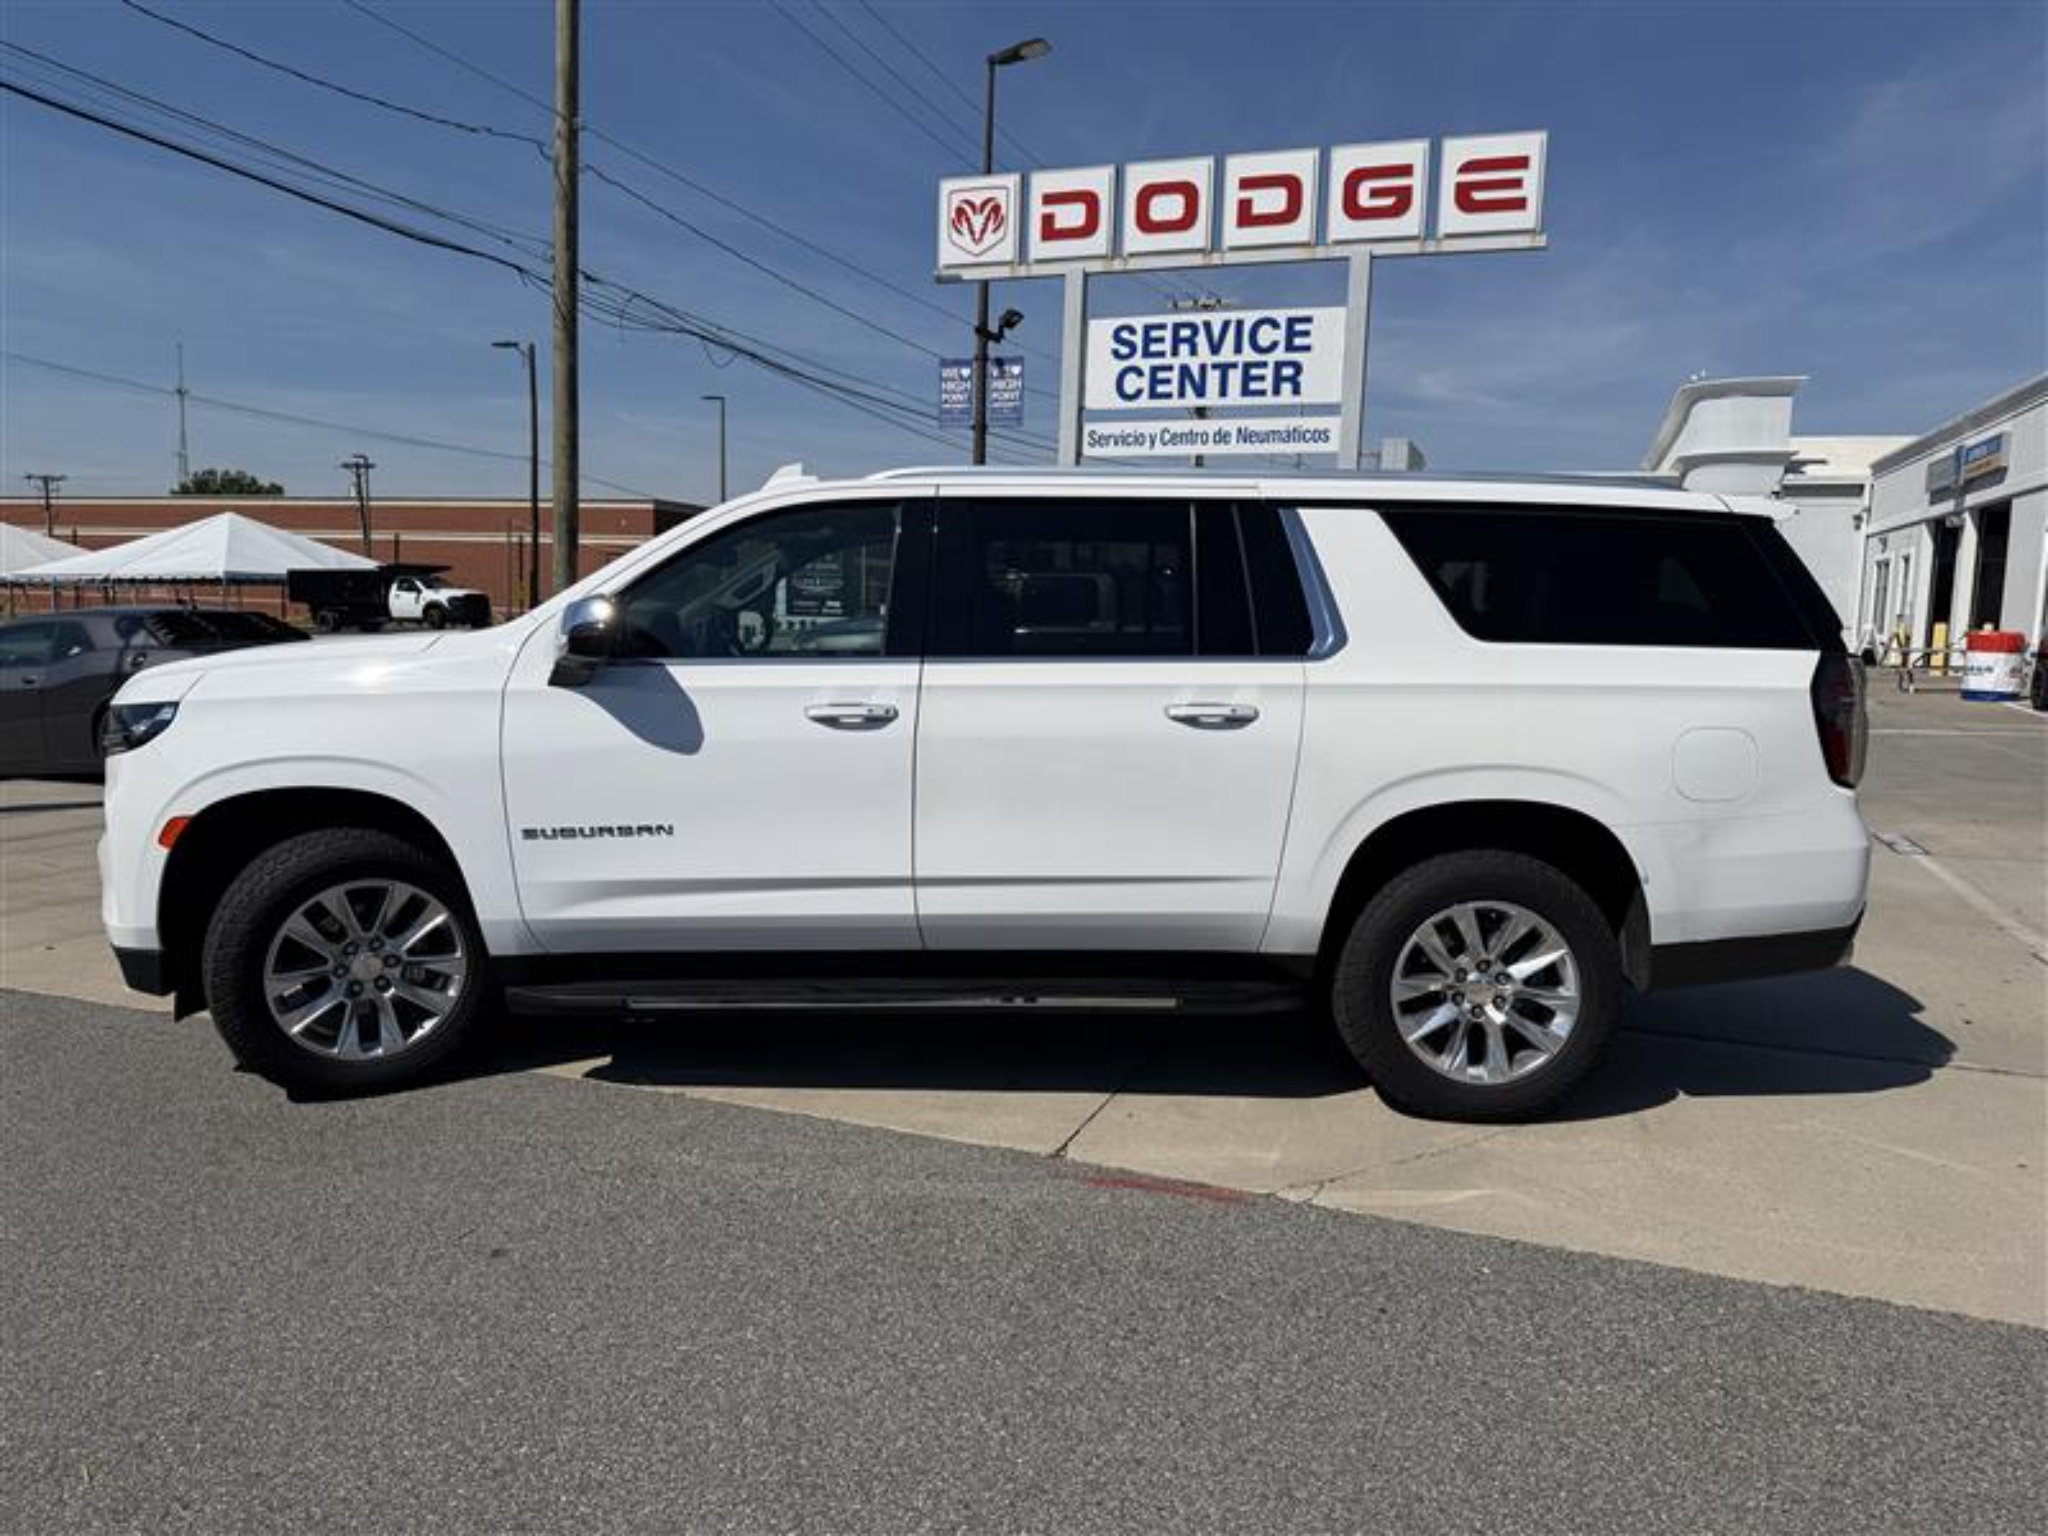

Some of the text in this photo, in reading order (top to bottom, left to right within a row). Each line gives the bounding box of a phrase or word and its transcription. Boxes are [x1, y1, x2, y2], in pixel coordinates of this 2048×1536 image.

[1040, 155, 1530, 242] DODGE
[1111, 316, 1313, 361] SERVICE
[1115, 360, 1304, 402] CENTER
[1087, 425, 1330, 450] Servicio y Centro de Neumáticos
[521, 824, 674, 840] SUBURBAN
